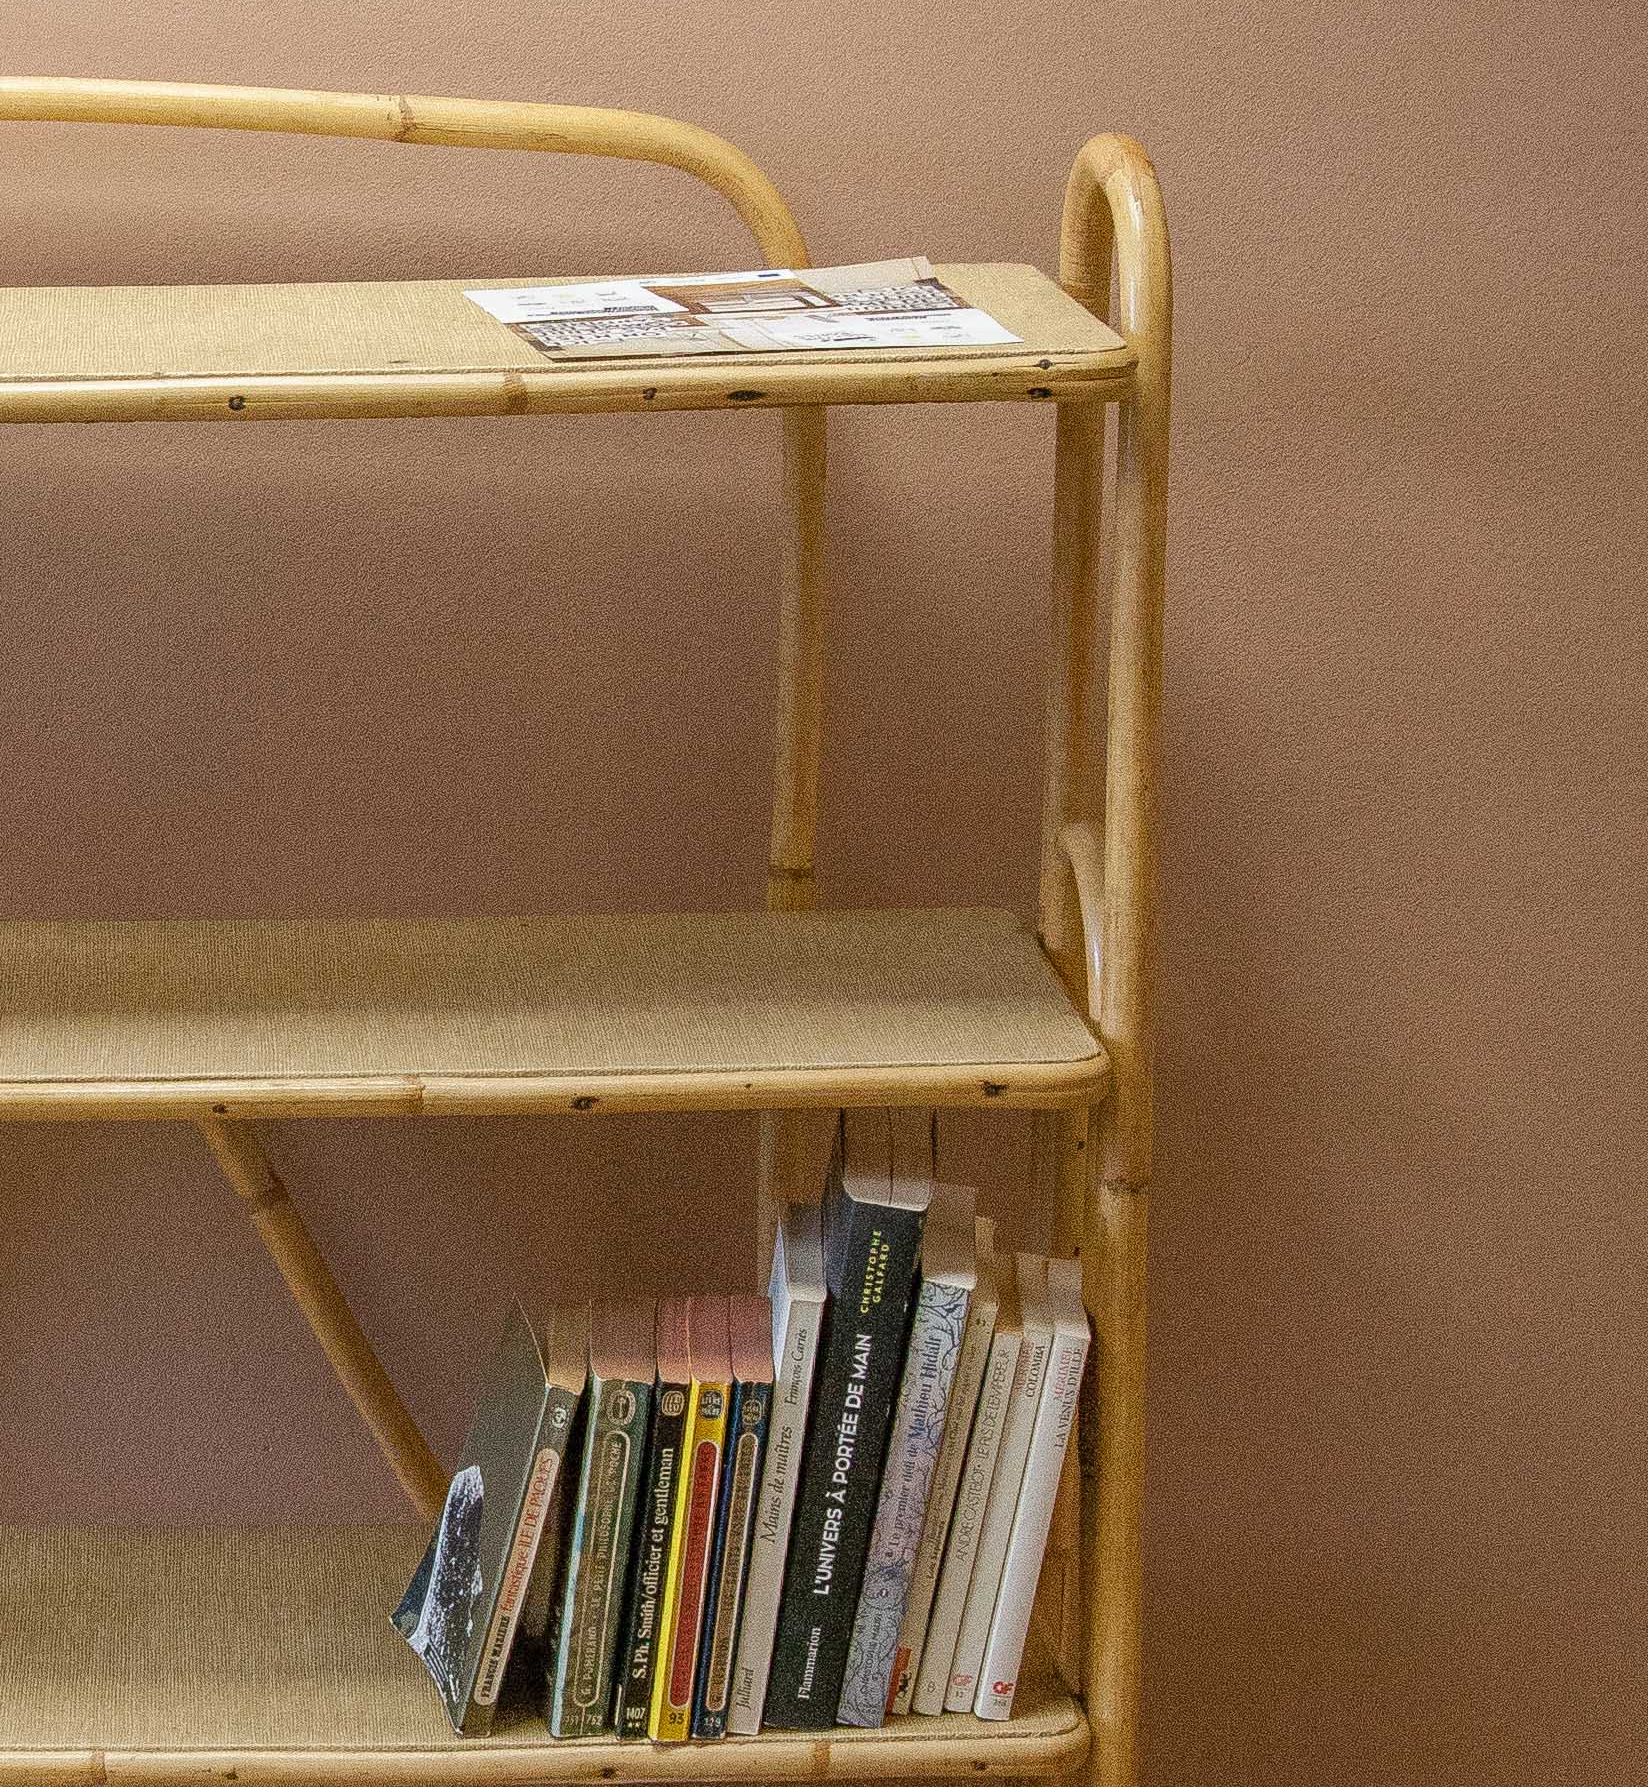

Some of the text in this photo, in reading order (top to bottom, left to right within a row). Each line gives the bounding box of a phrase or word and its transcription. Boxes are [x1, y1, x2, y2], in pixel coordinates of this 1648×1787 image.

[857, 1228, 883, 1314] CHRISTOPHE
[870, 1243, 890, 1303] GALFARD
[784, 1363, 804, 1405] François
[1023, 1343, 1045, 1398] COLOMBA
[981, 1408, 998, 1427] DE
[1055, 1387, 1075, 1429] VÉNUS
[606, 1441, 621, 1475] POCHE
[886, 1335, 943, 1547] Le premier défi de Mathieu Hidalf
[975, 1446, 989, 1459] LE
[978, 1427, 994, 1446] FILS
[1053, 1431, 1066, 1448] LA
[759, 1424, 792, 1543] Mains de maîtres
[812, 1331, 873, 1595] L'UNIVERS À PORTÉE DE MAIN
[650, 1446, 676, 1524] gentleman
[961, 1466, 985, 1521] CASTELOT
[649, 1526, 664, 1542] et
[480, 1657, 498, 1698] FRANCIS
[499, 1549, 530, 1613] fantastique
[523, 1509, 539, 1527] DE
[795, 1625, 822, 1700] Flammarion
[734, 1666, 757, 1709] Julliard
[626, 1707, 645, 1718] 1407
[670, 1712, 684, 1724] 93
